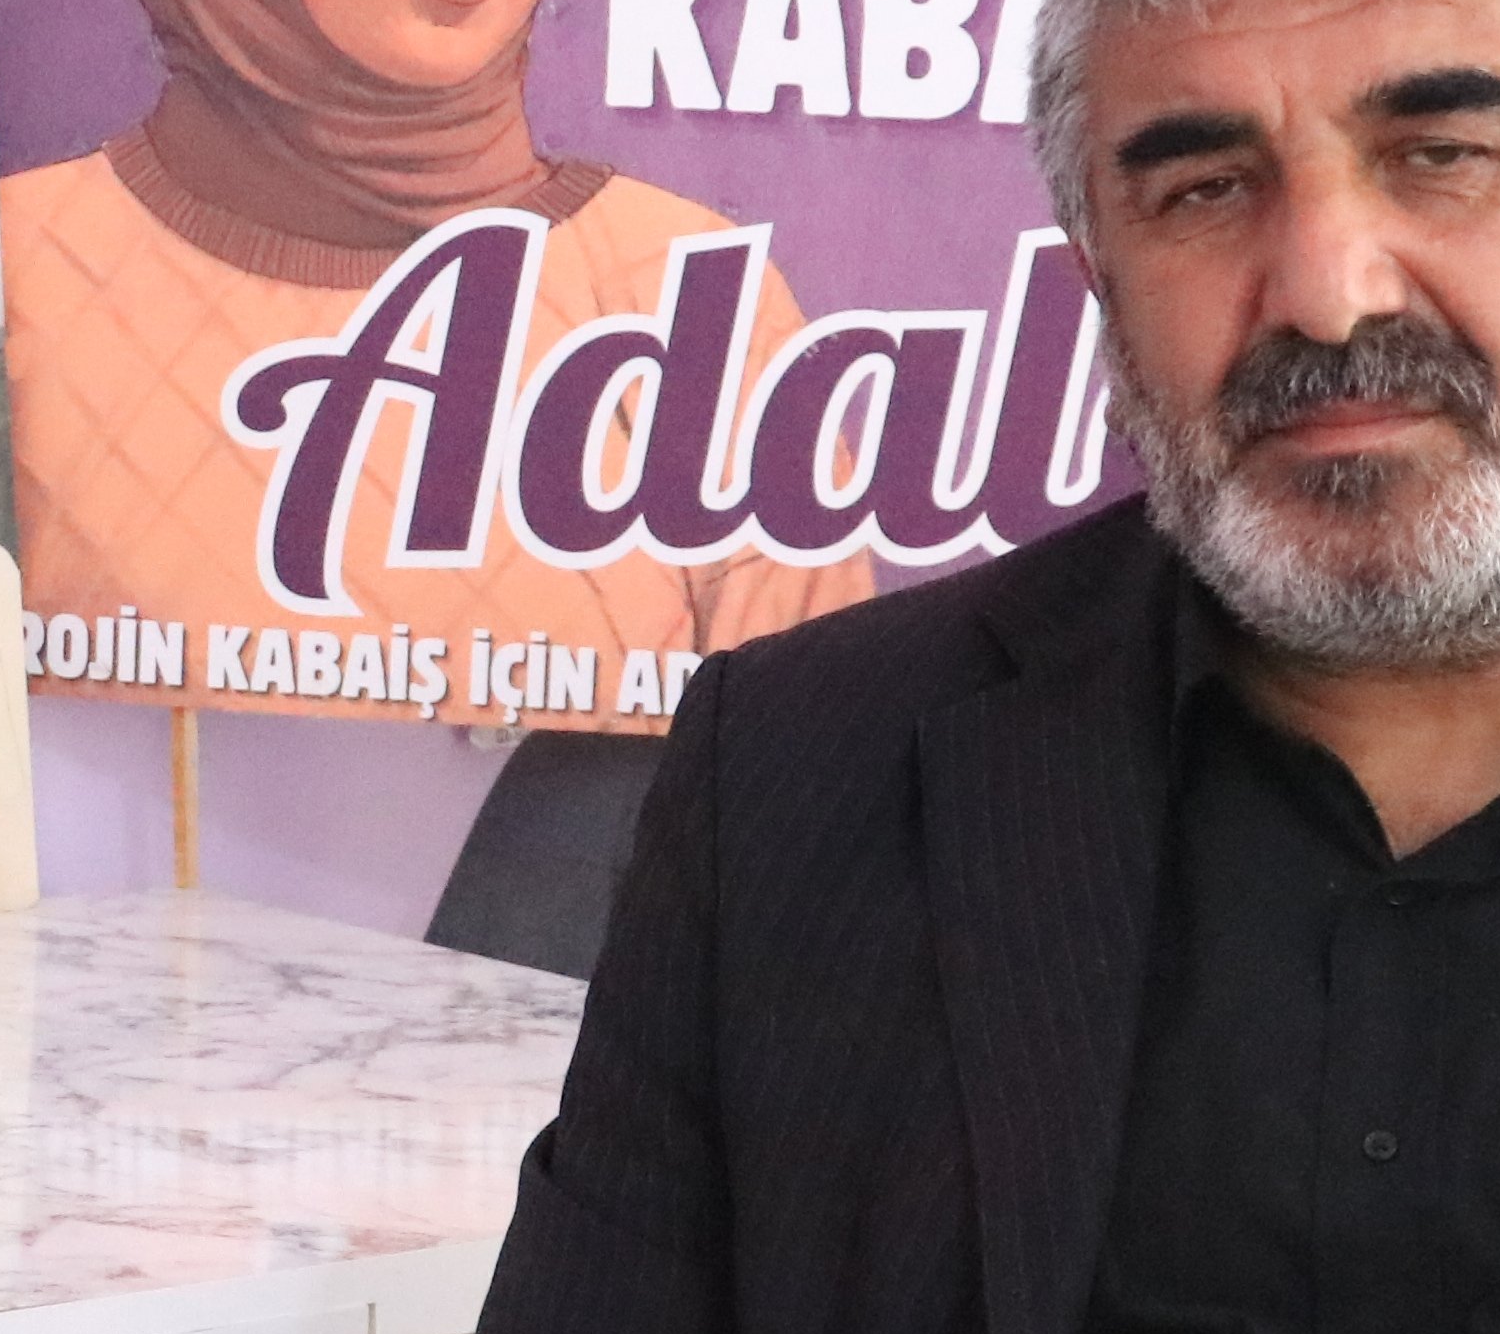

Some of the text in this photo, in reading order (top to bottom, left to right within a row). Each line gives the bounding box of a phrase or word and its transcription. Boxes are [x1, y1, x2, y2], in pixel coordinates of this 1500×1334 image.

[220, 206, 1110, 617] Adal
[23, 605, 704, 724] ROJİN KABAİŞ İÇİN AD
